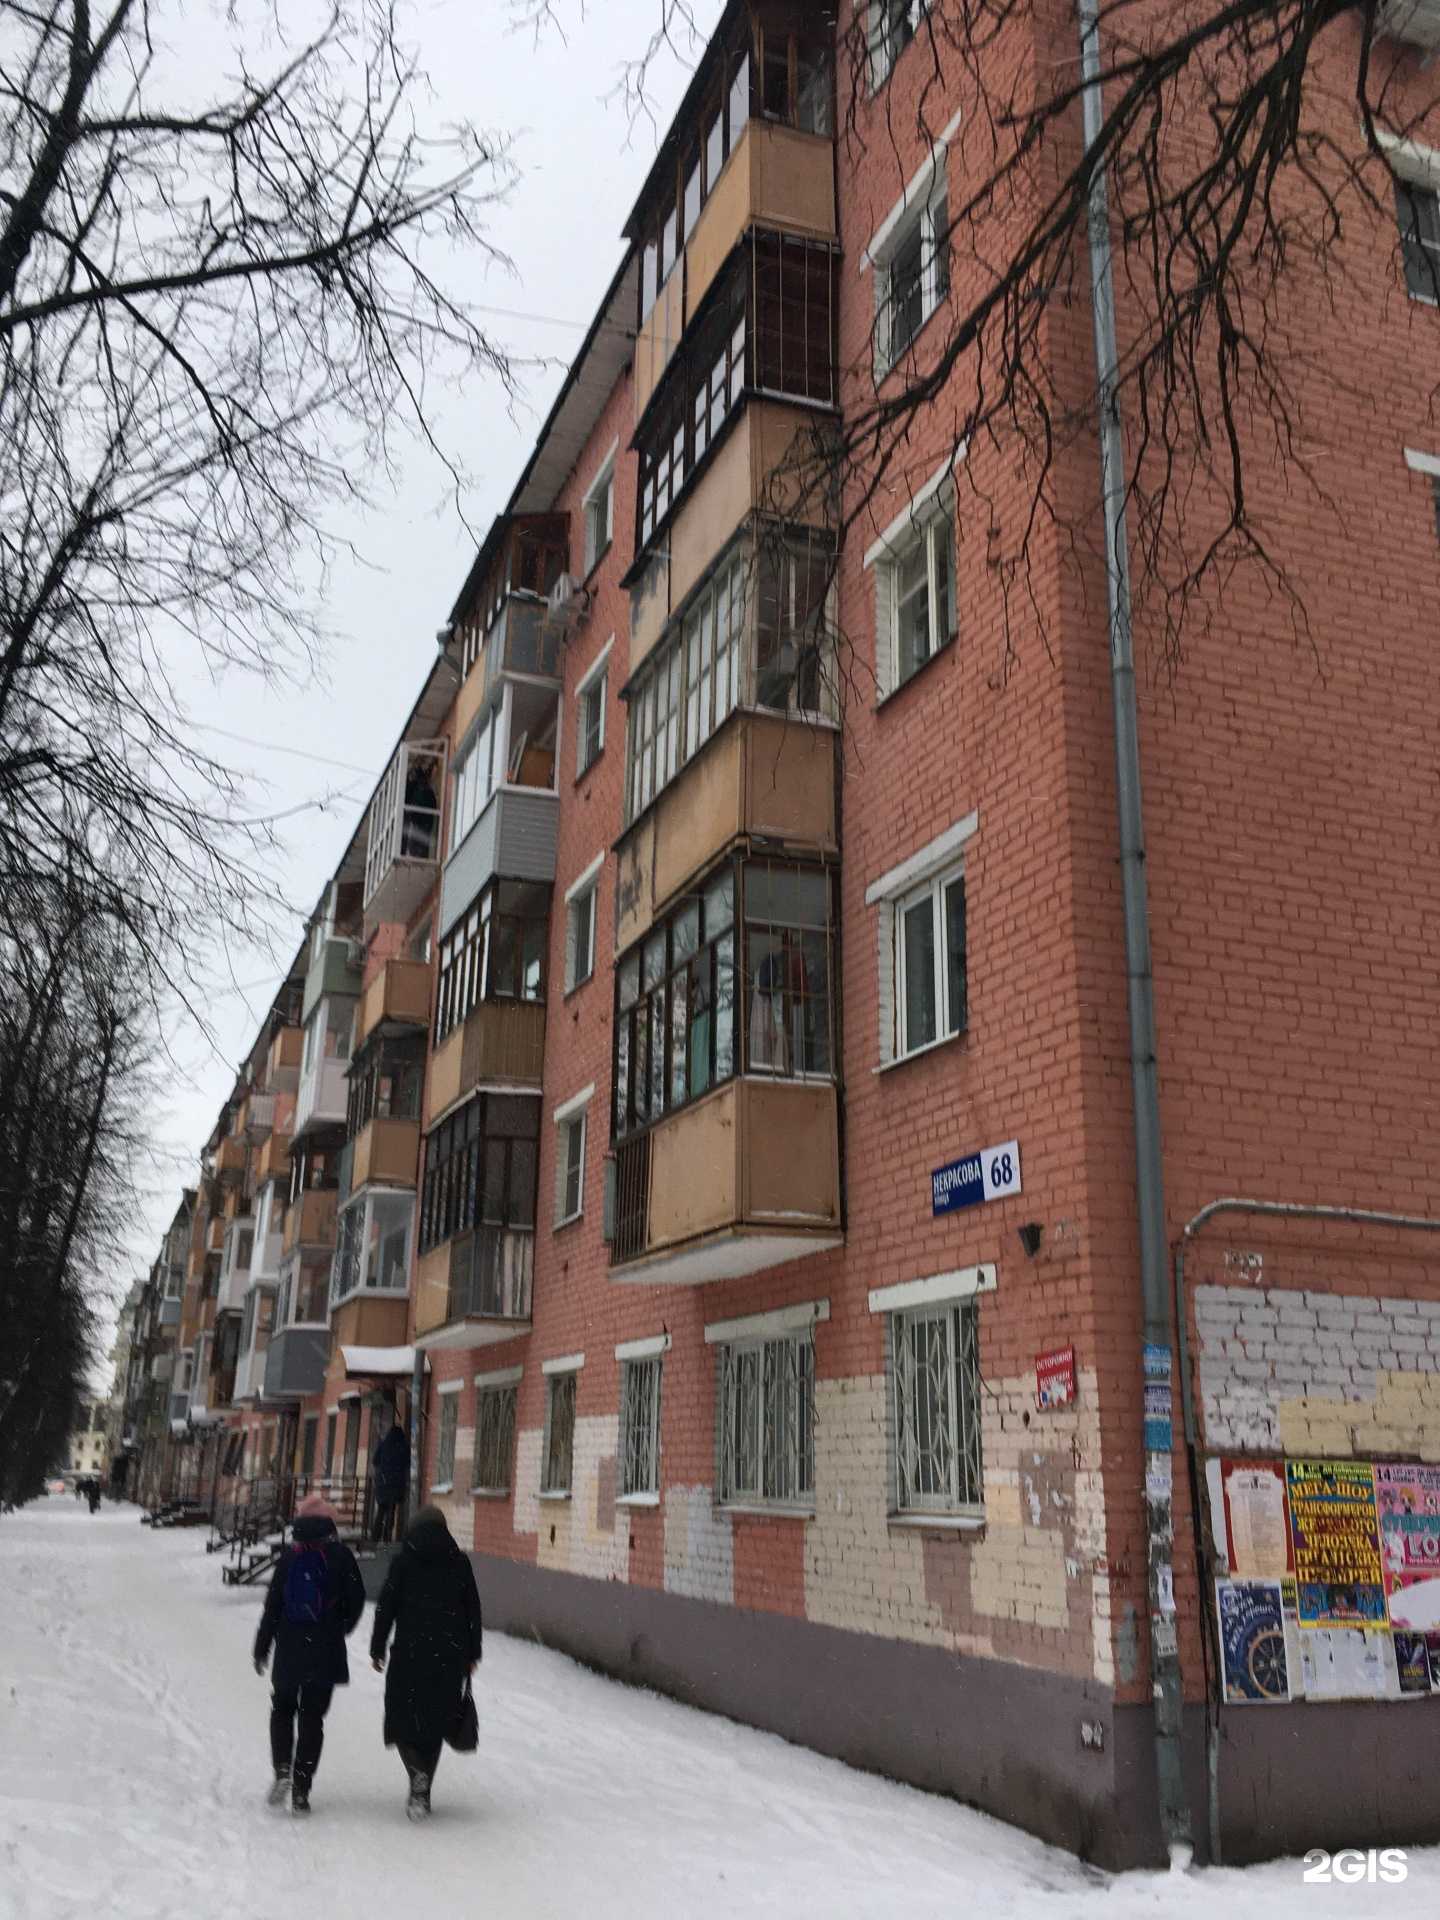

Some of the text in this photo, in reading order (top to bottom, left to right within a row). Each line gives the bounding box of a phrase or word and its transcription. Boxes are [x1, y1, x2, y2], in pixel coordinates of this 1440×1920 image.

[933, 1153, 1013, 1194] НЕКРАСОВА 68
[1291, 1480, 1372, 1499] МЕГА-ШОУ
[1292, 1500, 1375, 1516] ТРАНСФОРМЕРОВ
[1297, 1516, 1375, 1533] ЖЕОГО
